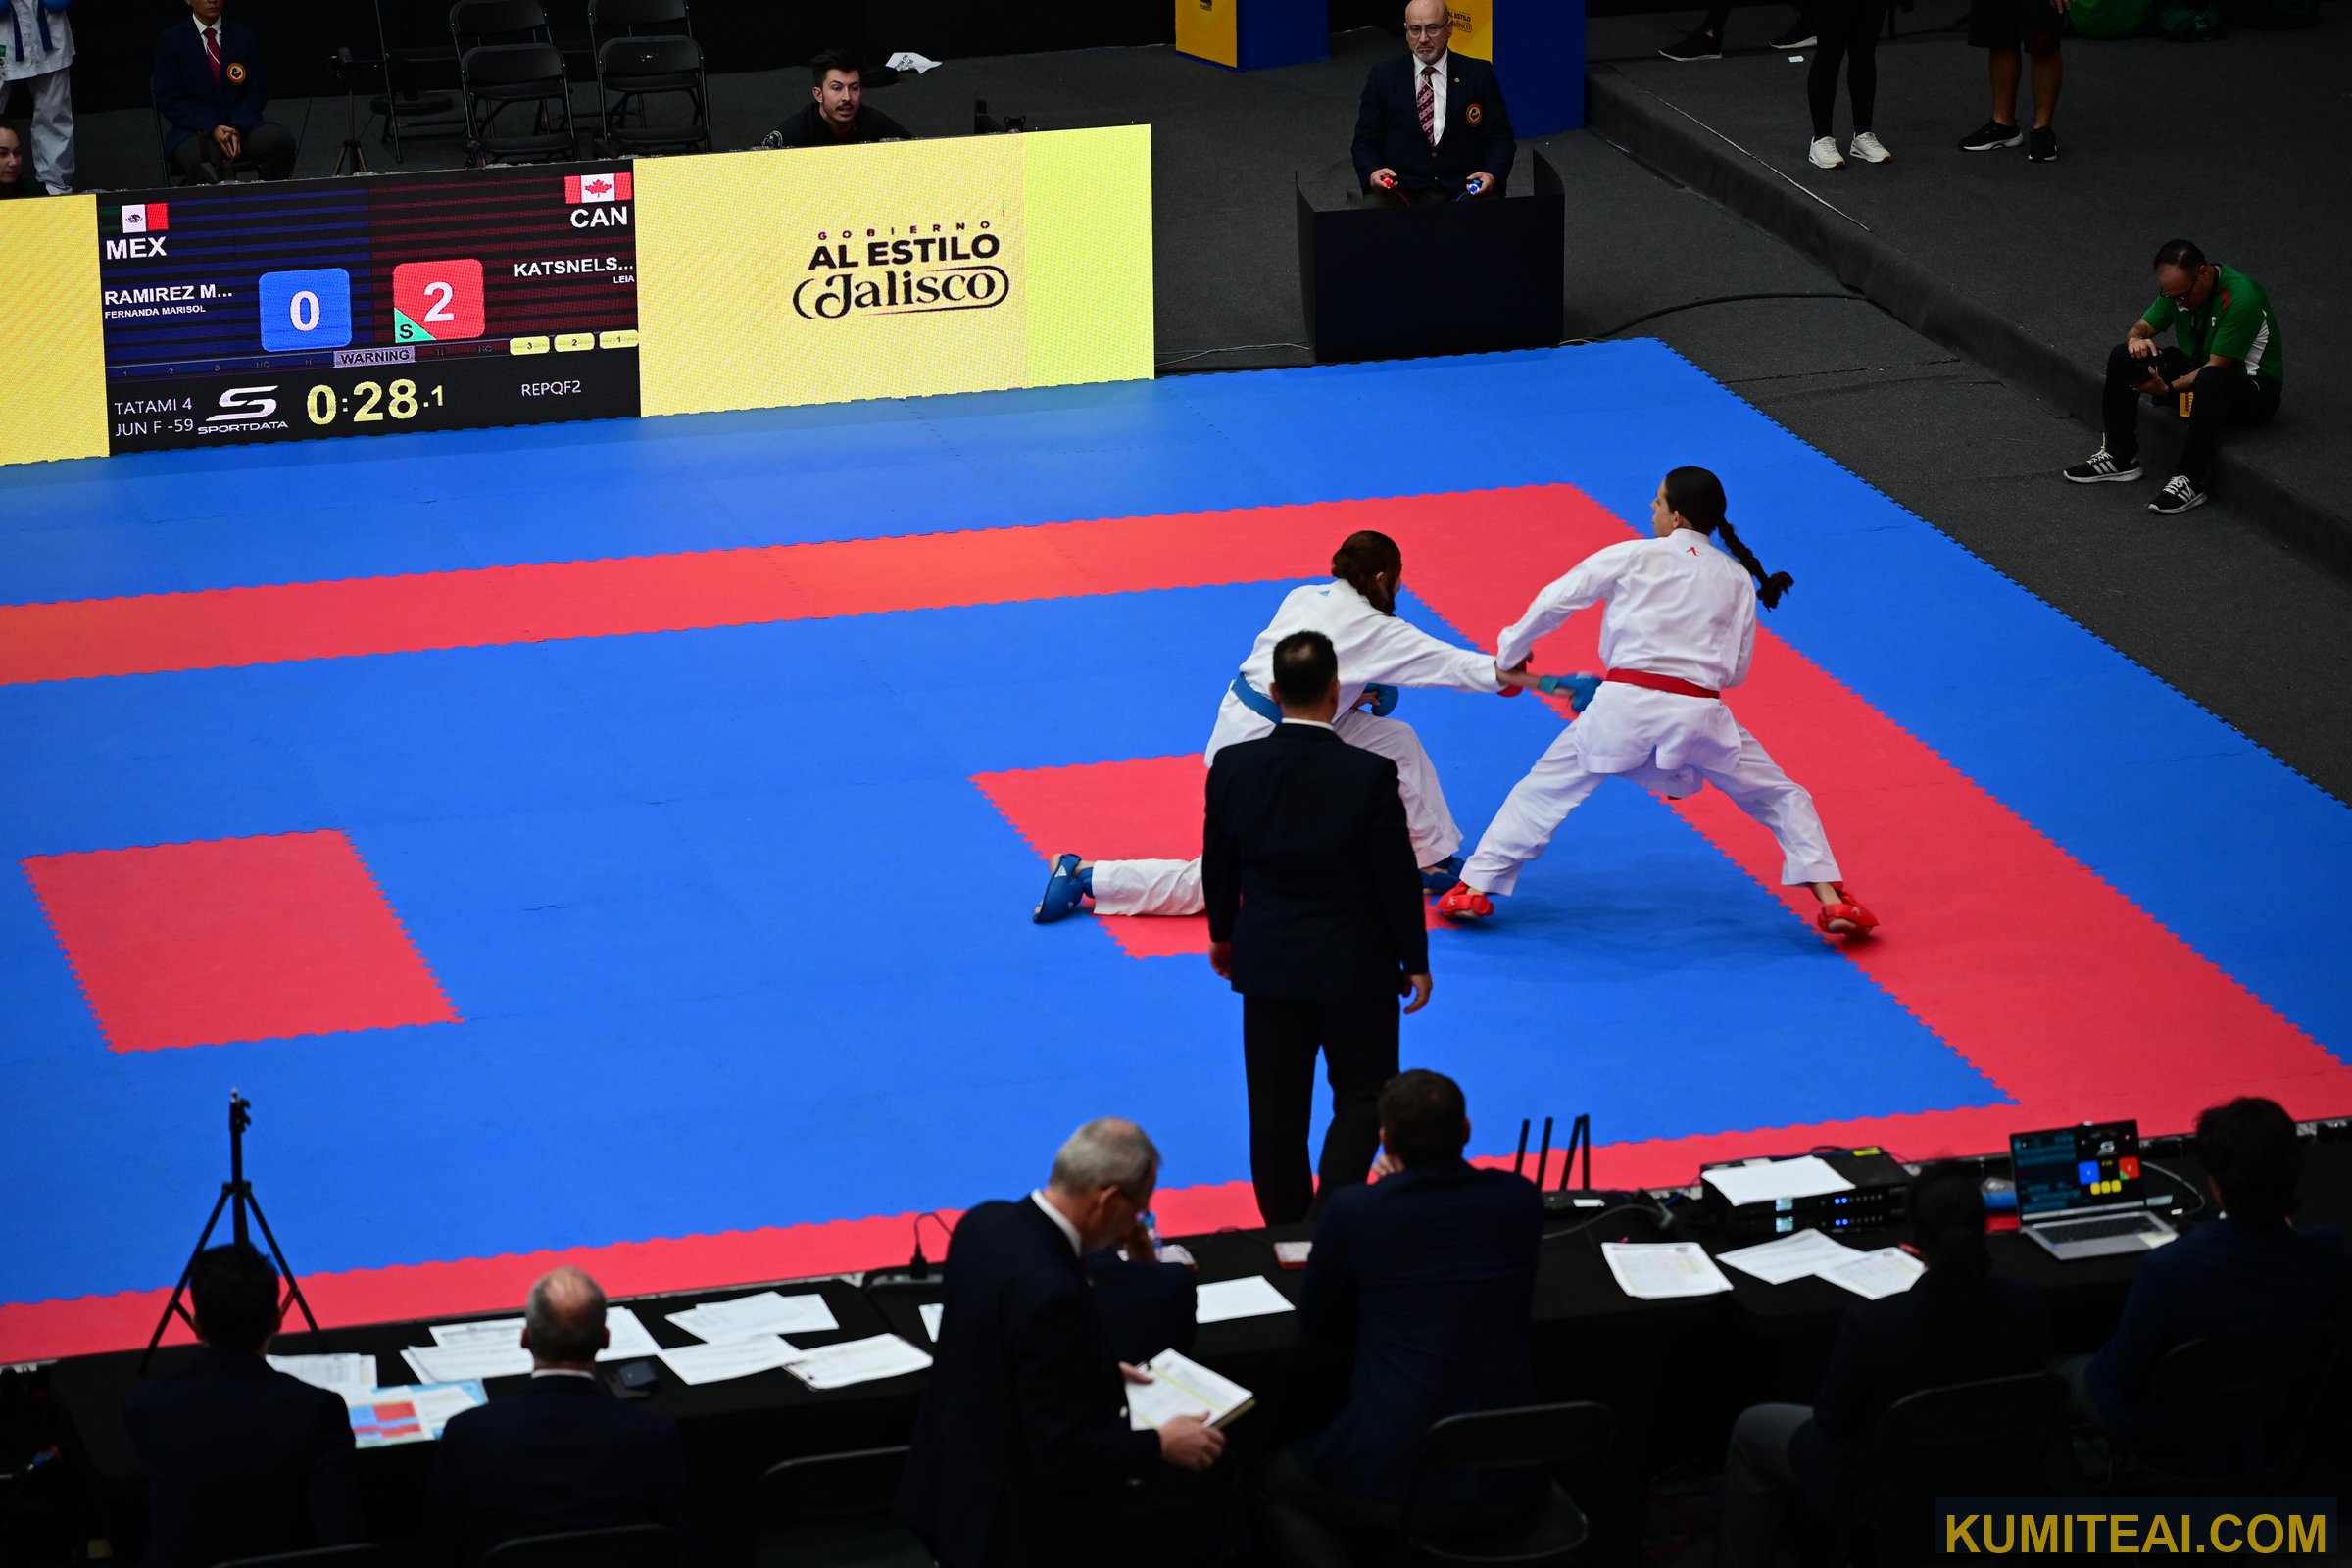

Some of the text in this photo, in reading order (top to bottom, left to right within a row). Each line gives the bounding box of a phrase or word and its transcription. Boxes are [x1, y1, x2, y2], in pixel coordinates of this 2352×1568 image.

[569, 206, 628, 228] CAN
[817, 220, 991, 241] GOBIERNO
[105, 236, 168, 260] MEX
[808, 233, 1000, 270] AL ESTILO
[514, 257, 633, 277] KATSNELS...
[613, 274, 635, 284] LEIA
[104, 284, 233, 305] RAMIREZ M...
[423, 281, 455, 323] 2
[814, 270, 996, 318] Jalisco
[104, 304, 206, 318] FERNANDA MARISOL
[289, 290, 320, 332] 0
[399, 324, 414, 340] S
[571, 338, 578, 347] 2
[340, 349, 410, 365] WARNING
[521, 380, 582, 397] REPQF2
[114, 397, 193, 416] TATAMI 4
[115, 418, 194, 437] JUN F -59
[197, 420, 289, 435] SPORTDATA
